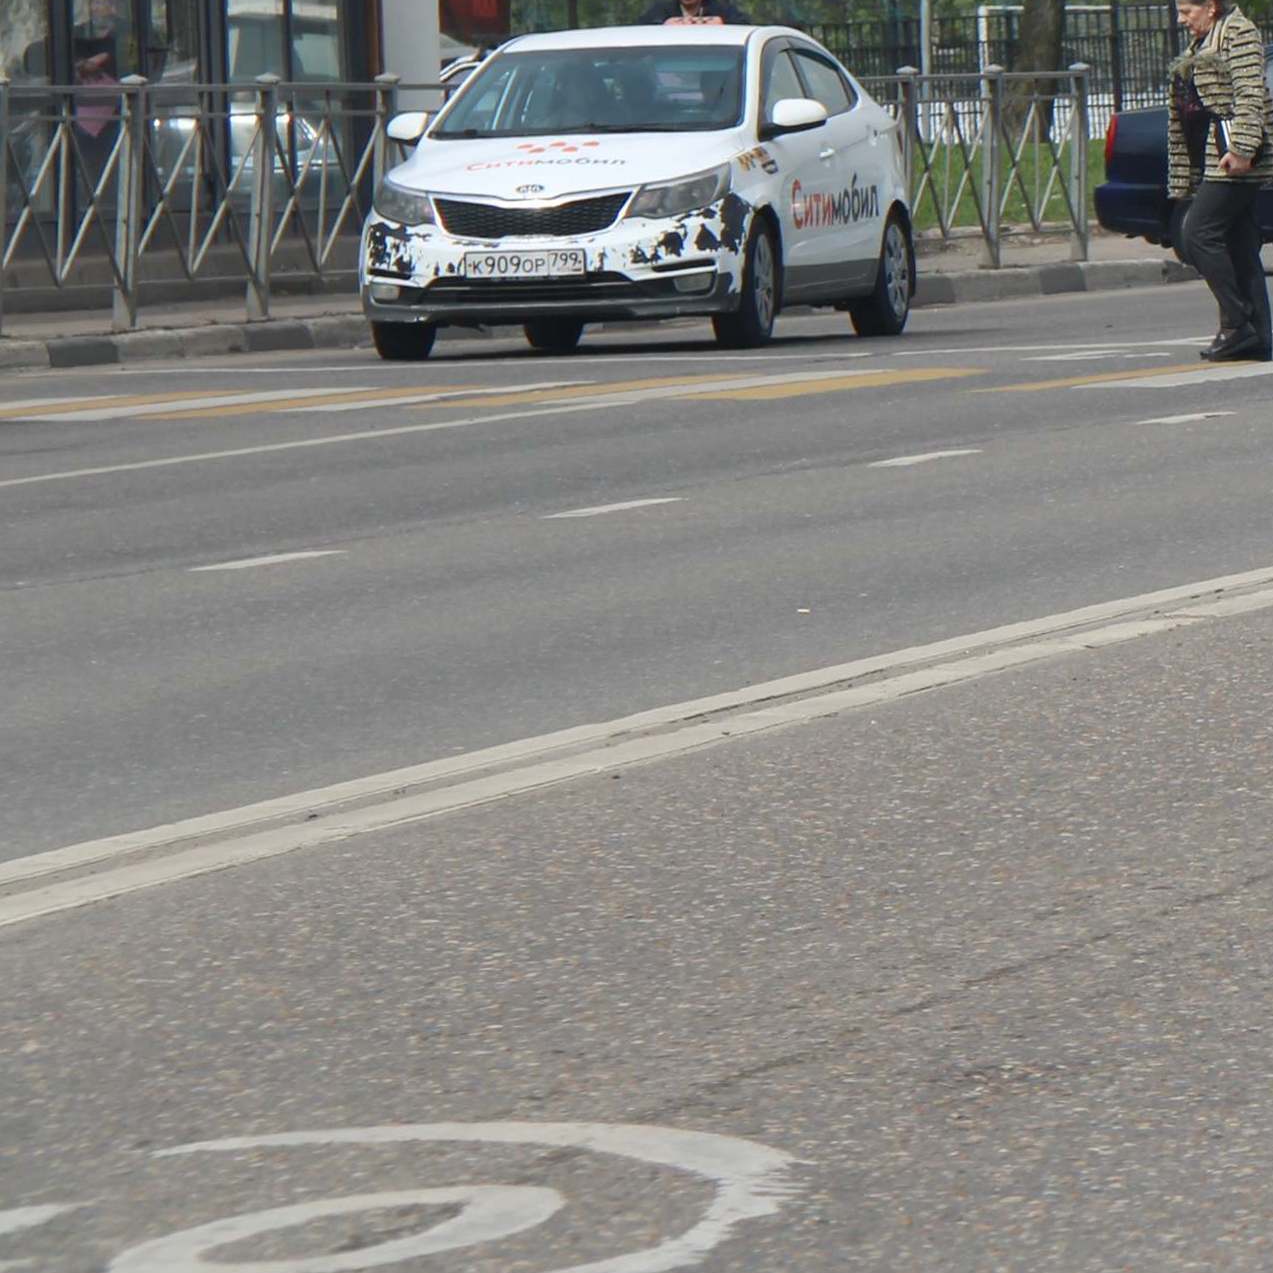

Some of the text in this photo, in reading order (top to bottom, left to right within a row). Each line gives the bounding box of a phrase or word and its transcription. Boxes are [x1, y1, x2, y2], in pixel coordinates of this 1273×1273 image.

[791, 173, 879, 230] Ситимобил
[472, 252, 579, 275] К909ОР 799
